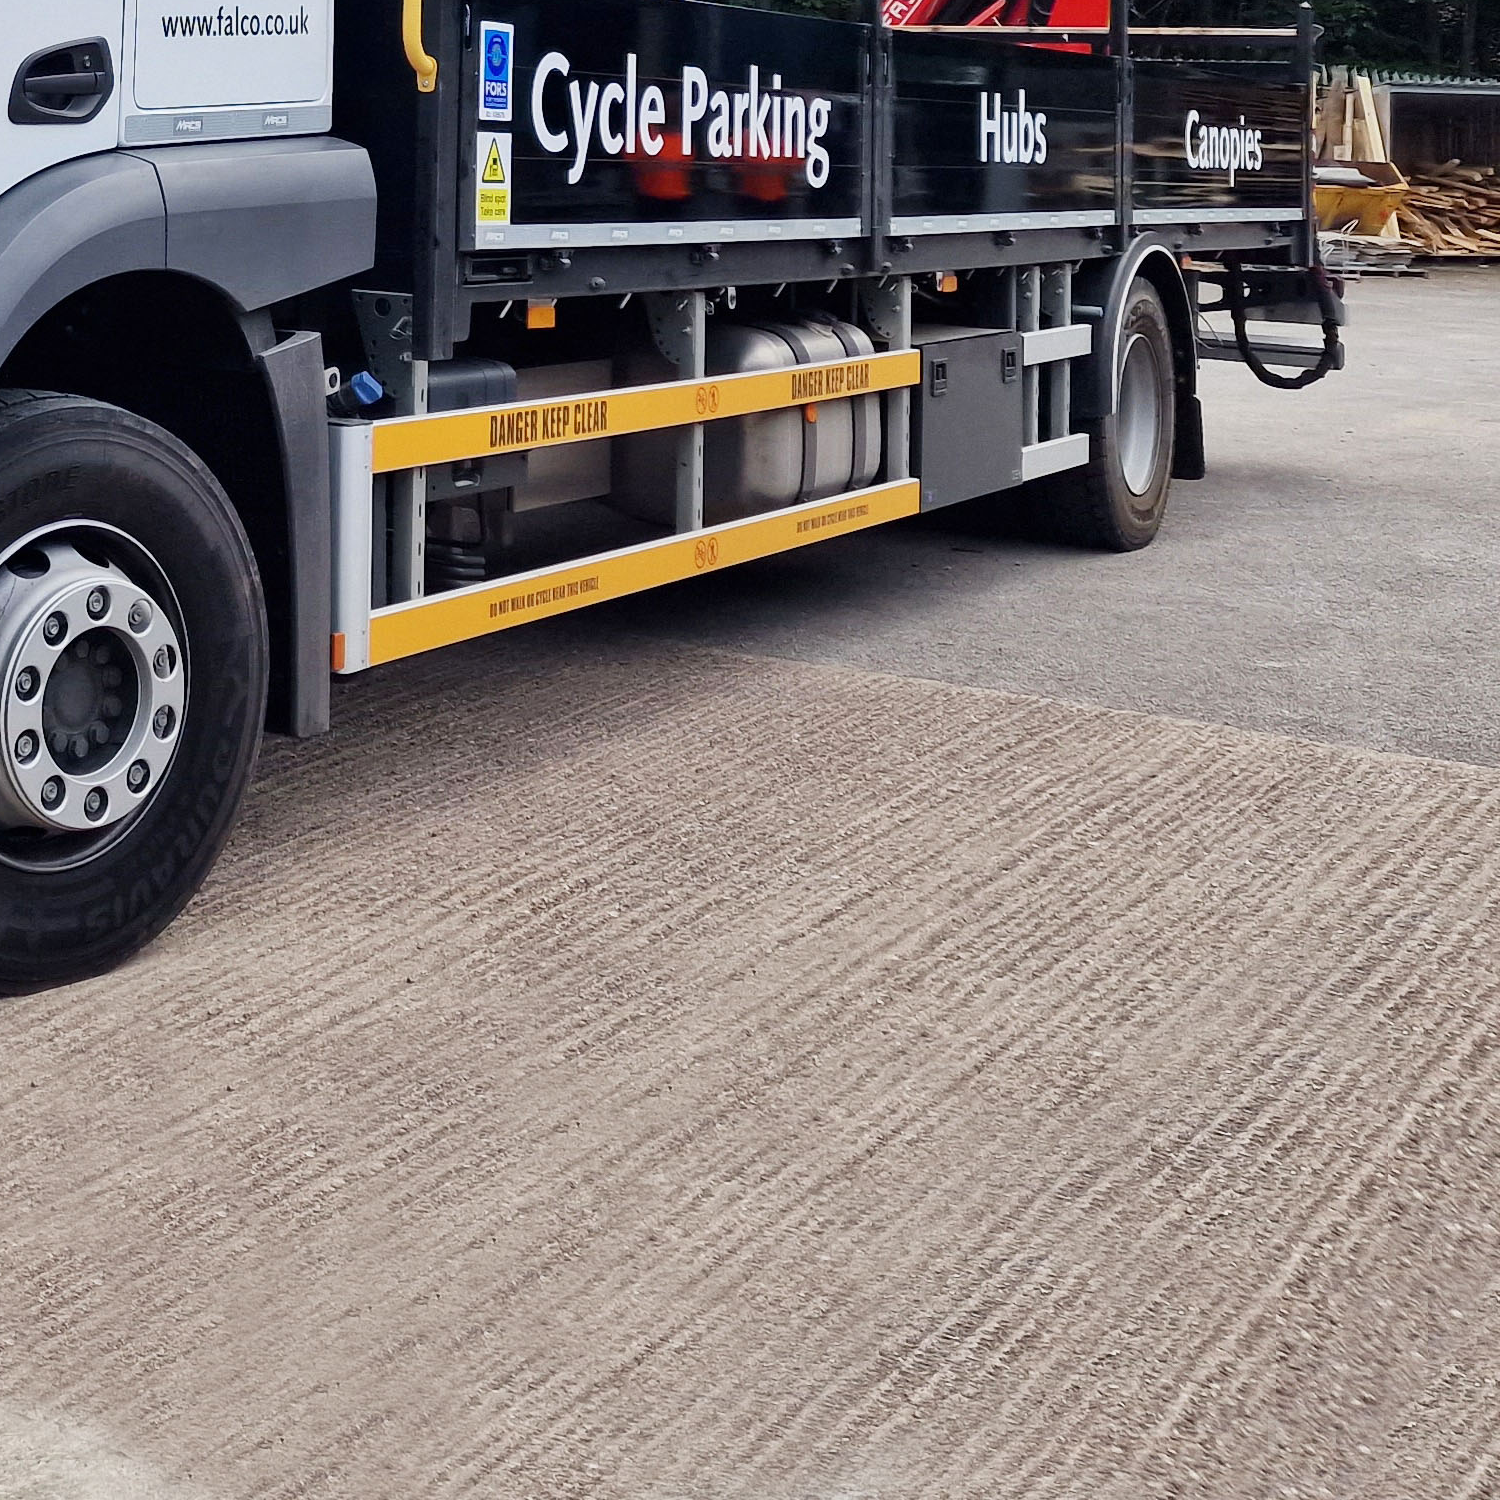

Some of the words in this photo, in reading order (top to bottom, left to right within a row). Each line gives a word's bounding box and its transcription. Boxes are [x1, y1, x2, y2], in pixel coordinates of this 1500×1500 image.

[161, 5, 309, 38] www.falco.co.uk
[485, 81, 507, 96] FORS
[532, 51, 666, 185] Cycle
[682, 64, 832, 189] Parking
[980, 88, 1048, 164] Hubs
[1184, 109, 1263, 188] Canopies
[791, 370, 823, 400] DANGER
[825, 367, 844, 395] KEEP
[846, 363, 870, 391] CLEAR
[489, 409, 538, 448] DANGER
[542, 405, 570, 440] KEEP
[574, 400, 608, 435] CLEAR
